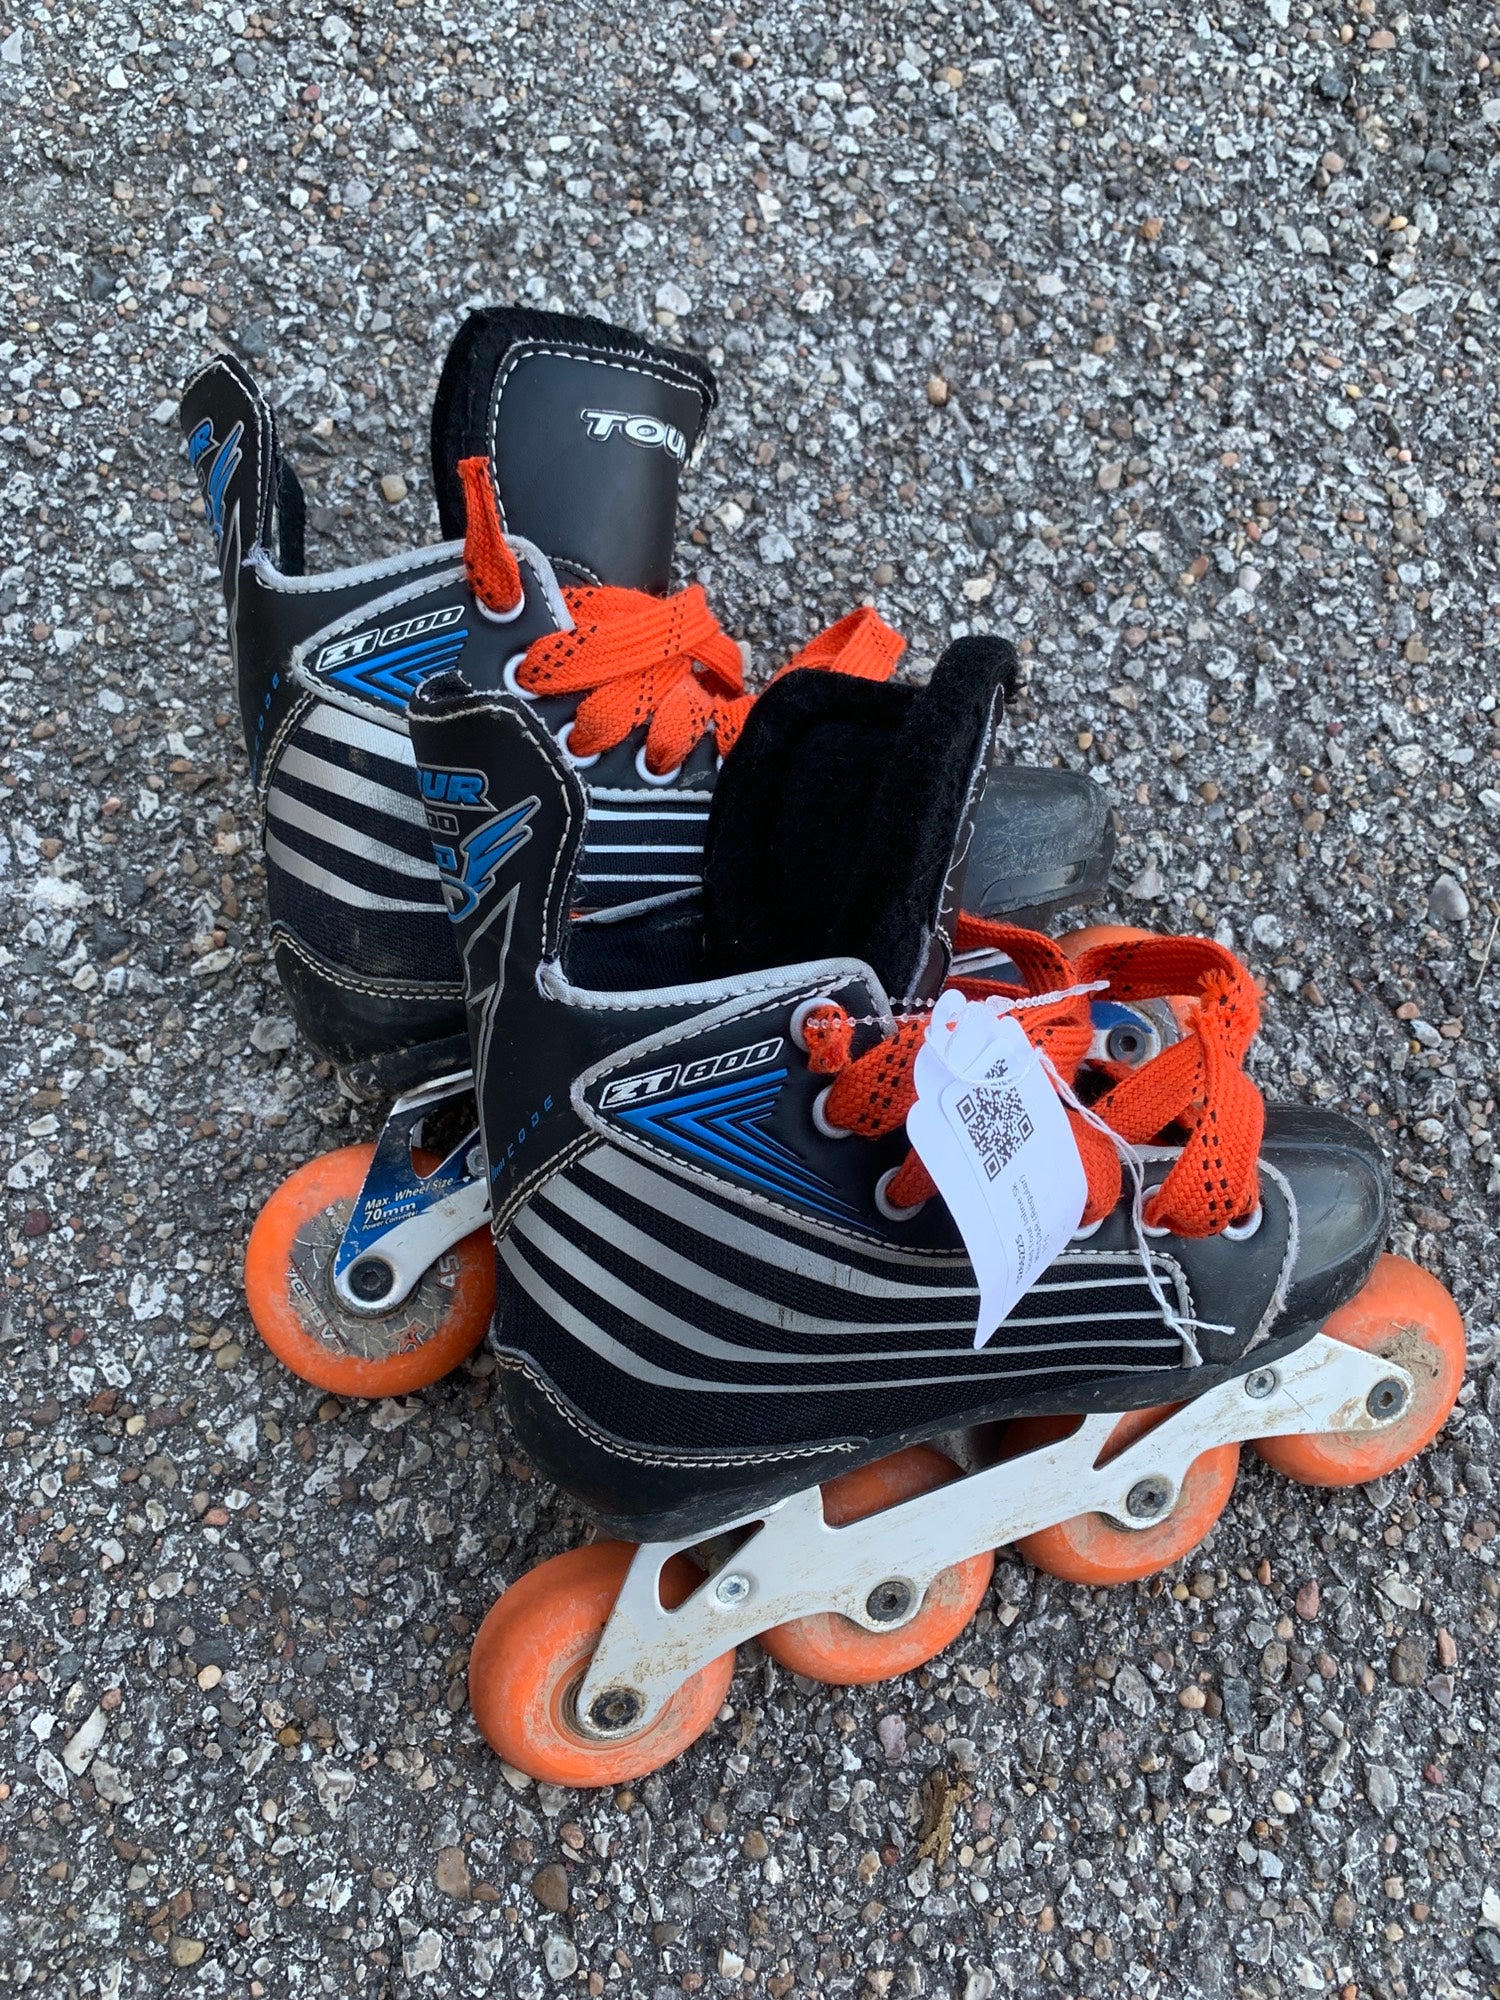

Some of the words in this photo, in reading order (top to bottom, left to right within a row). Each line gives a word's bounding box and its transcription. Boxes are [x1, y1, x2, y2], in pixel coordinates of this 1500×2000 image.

[318, 630, 378, 670] ZT
[379, 605, 465, 647] 800
[417, 766, 488, 807] UR
[602, 1066, 679, 1107] ZT
[680, 1036, 784, 1086] 800
[507, 1094, 553, 1159] CODE
[364, 1197, 391, 1211] Max.
[395, 1184, 429, 1202] Wheel
[432, 1177, 454, 1191] Size
[364, 1202, 416, 1224] 70mm
[1019, 1174, 1038, 1221] (Regular)
